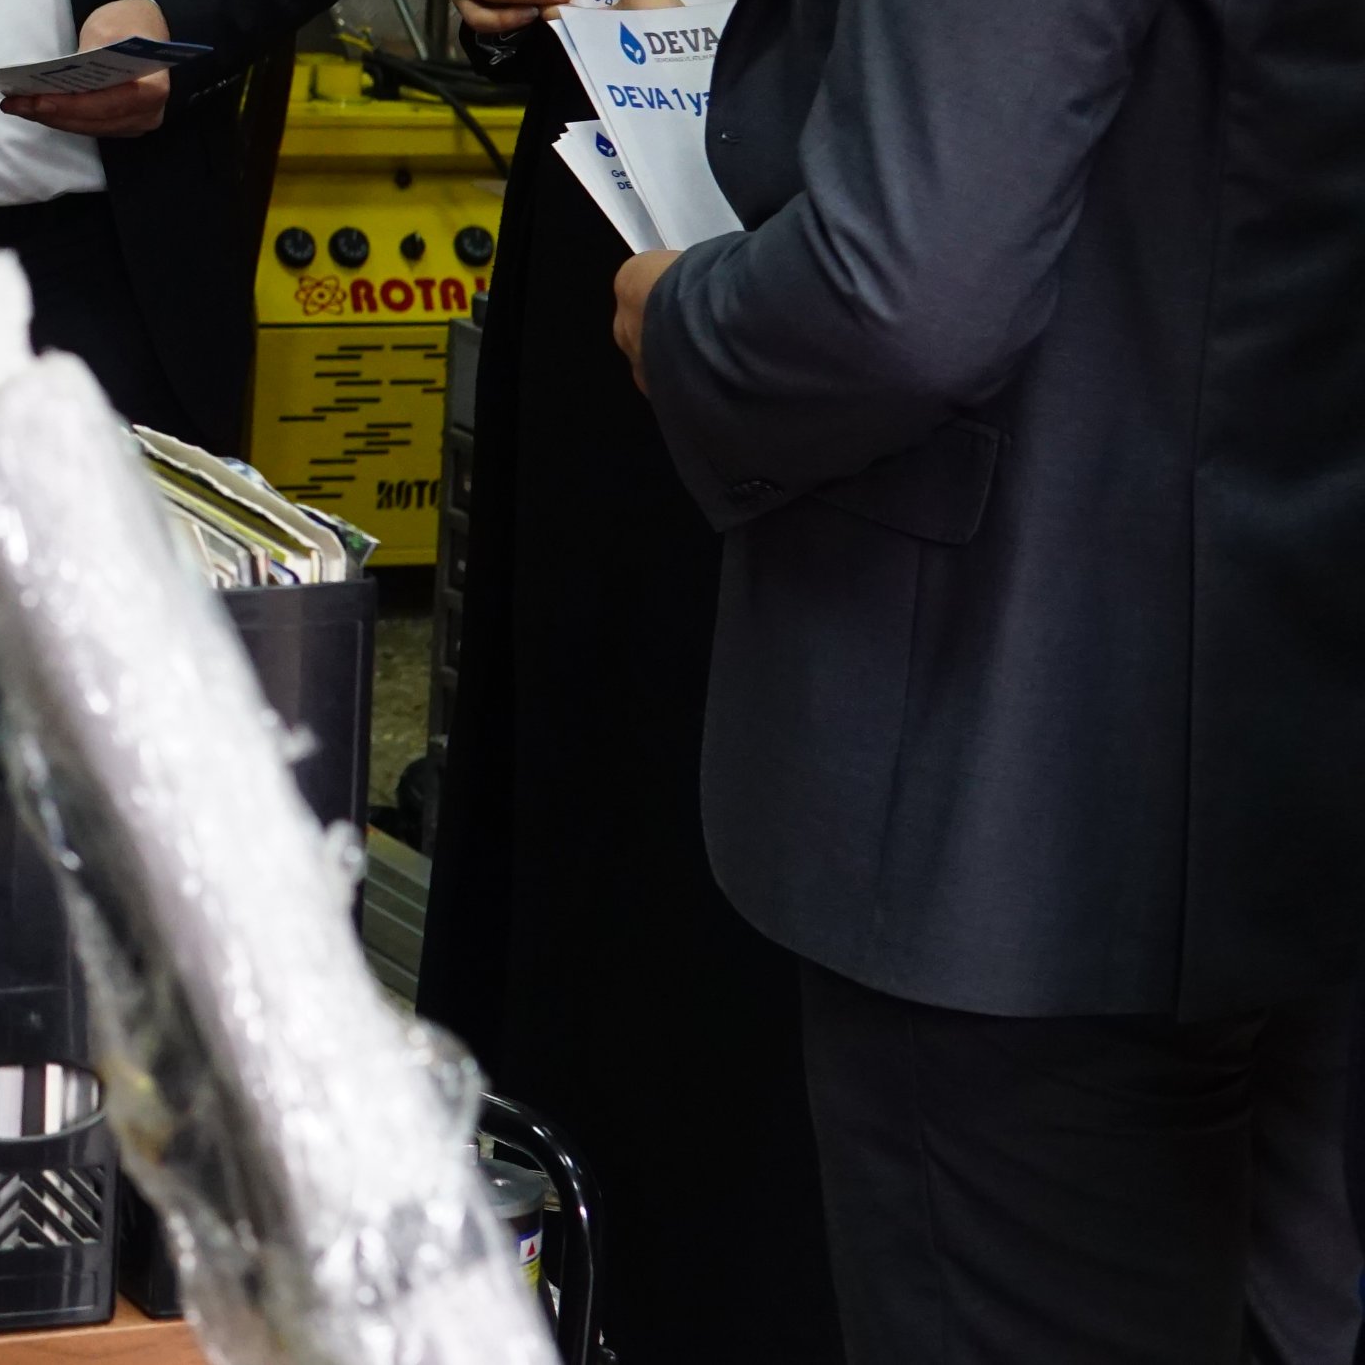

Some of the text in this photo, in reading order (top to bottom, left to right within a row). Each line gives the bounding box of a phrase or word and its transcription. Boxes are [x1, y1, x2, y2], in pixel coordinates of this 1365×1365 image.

[643, 26, 719, 55] DEVA
[606, 84, 674, 111] DEVA
[671, 88, 687, 111] 1
[350, 277, 488, 313] ROTA
